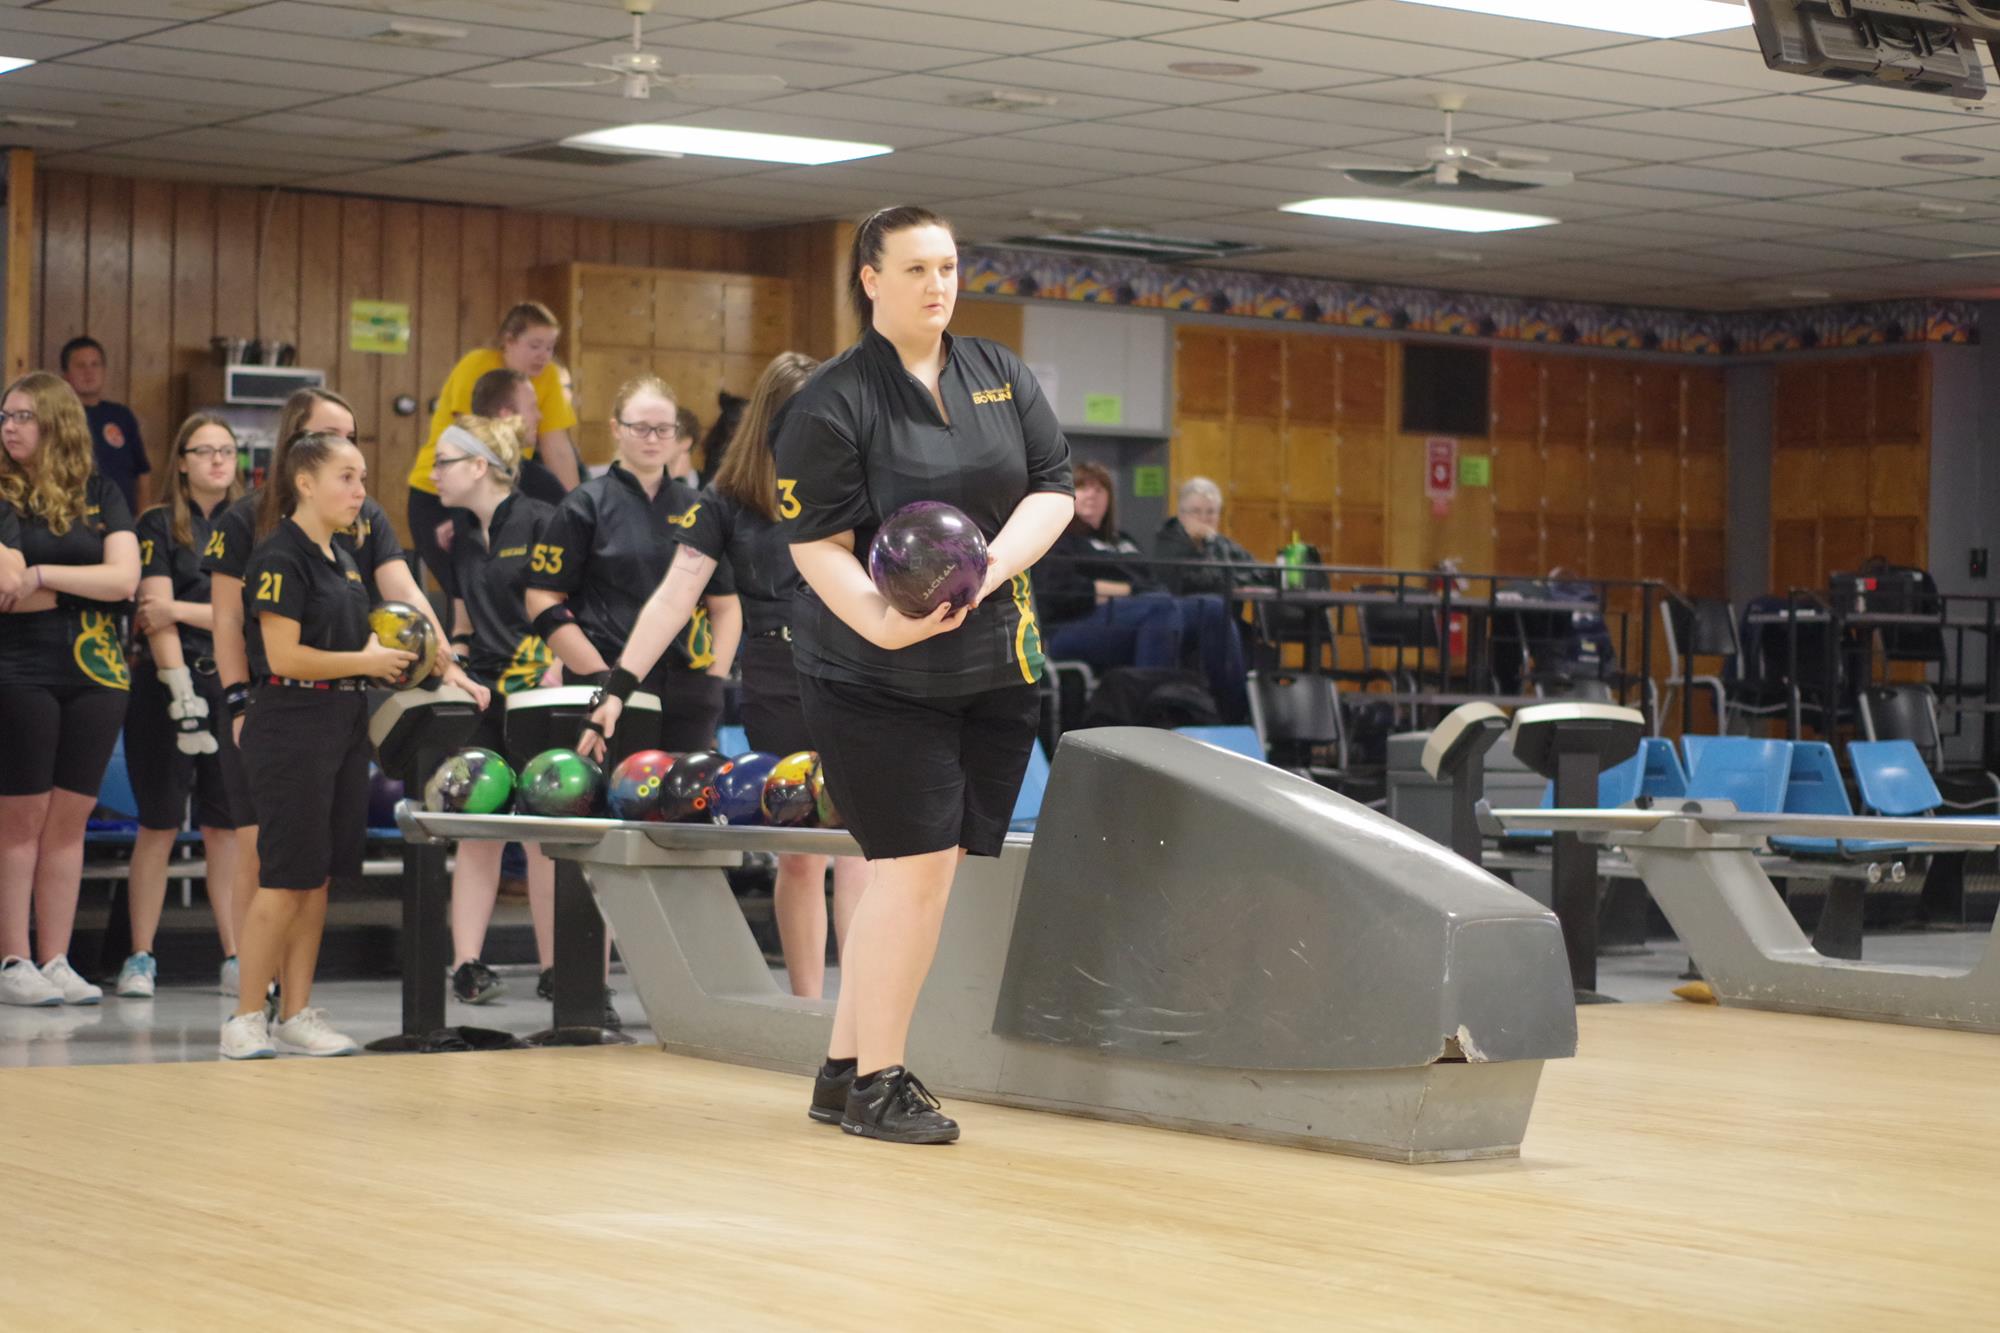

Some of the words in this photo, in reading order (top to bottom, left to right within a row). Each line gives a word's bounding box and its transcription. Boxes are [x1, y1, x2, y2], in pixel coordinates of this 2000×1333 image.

[973, 391, 1012, 405] BOWLIN
[777, 479, 802, 519] 3
[681, 503, 702, 528] 6
[140, 539, 154, 566] 7
[531, 543, 565, 575] 53
[256, 571, 283, 604] 21
